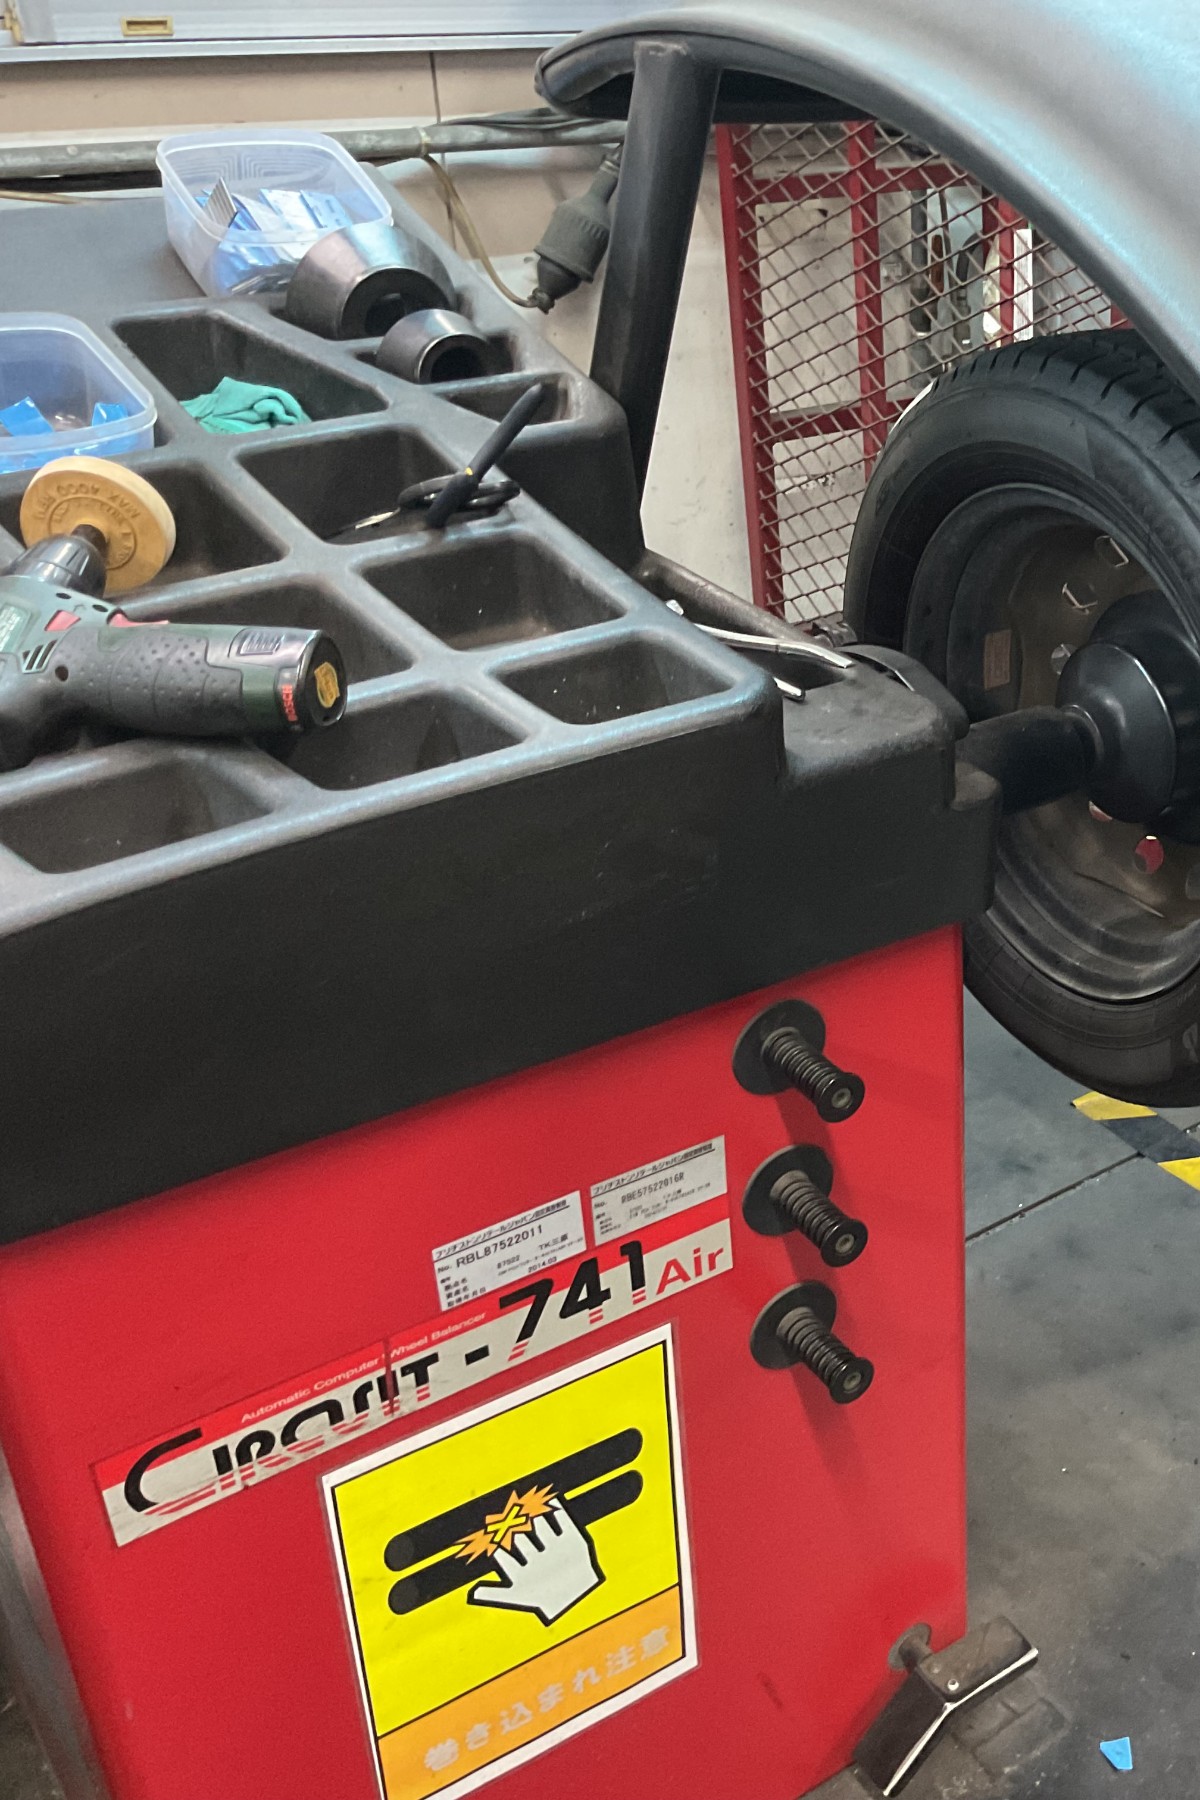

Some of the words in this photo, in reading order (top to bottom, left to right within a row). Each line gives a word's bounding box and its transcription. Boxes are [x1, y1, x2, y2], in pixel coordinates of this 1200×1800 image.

[456, 1224, 543, 1269] RBL87522011
[656, 1247, 725, 1295] Air
[241, 1388, 311, 1424] Automatic
[313, 1357, 380, 1392] Computer
[382, 1335, 429, 1362] Wheel
[431, 1311, 486, 1342] Balancer
[424, 1625, 670, 1772] 巻き込まれ注意
